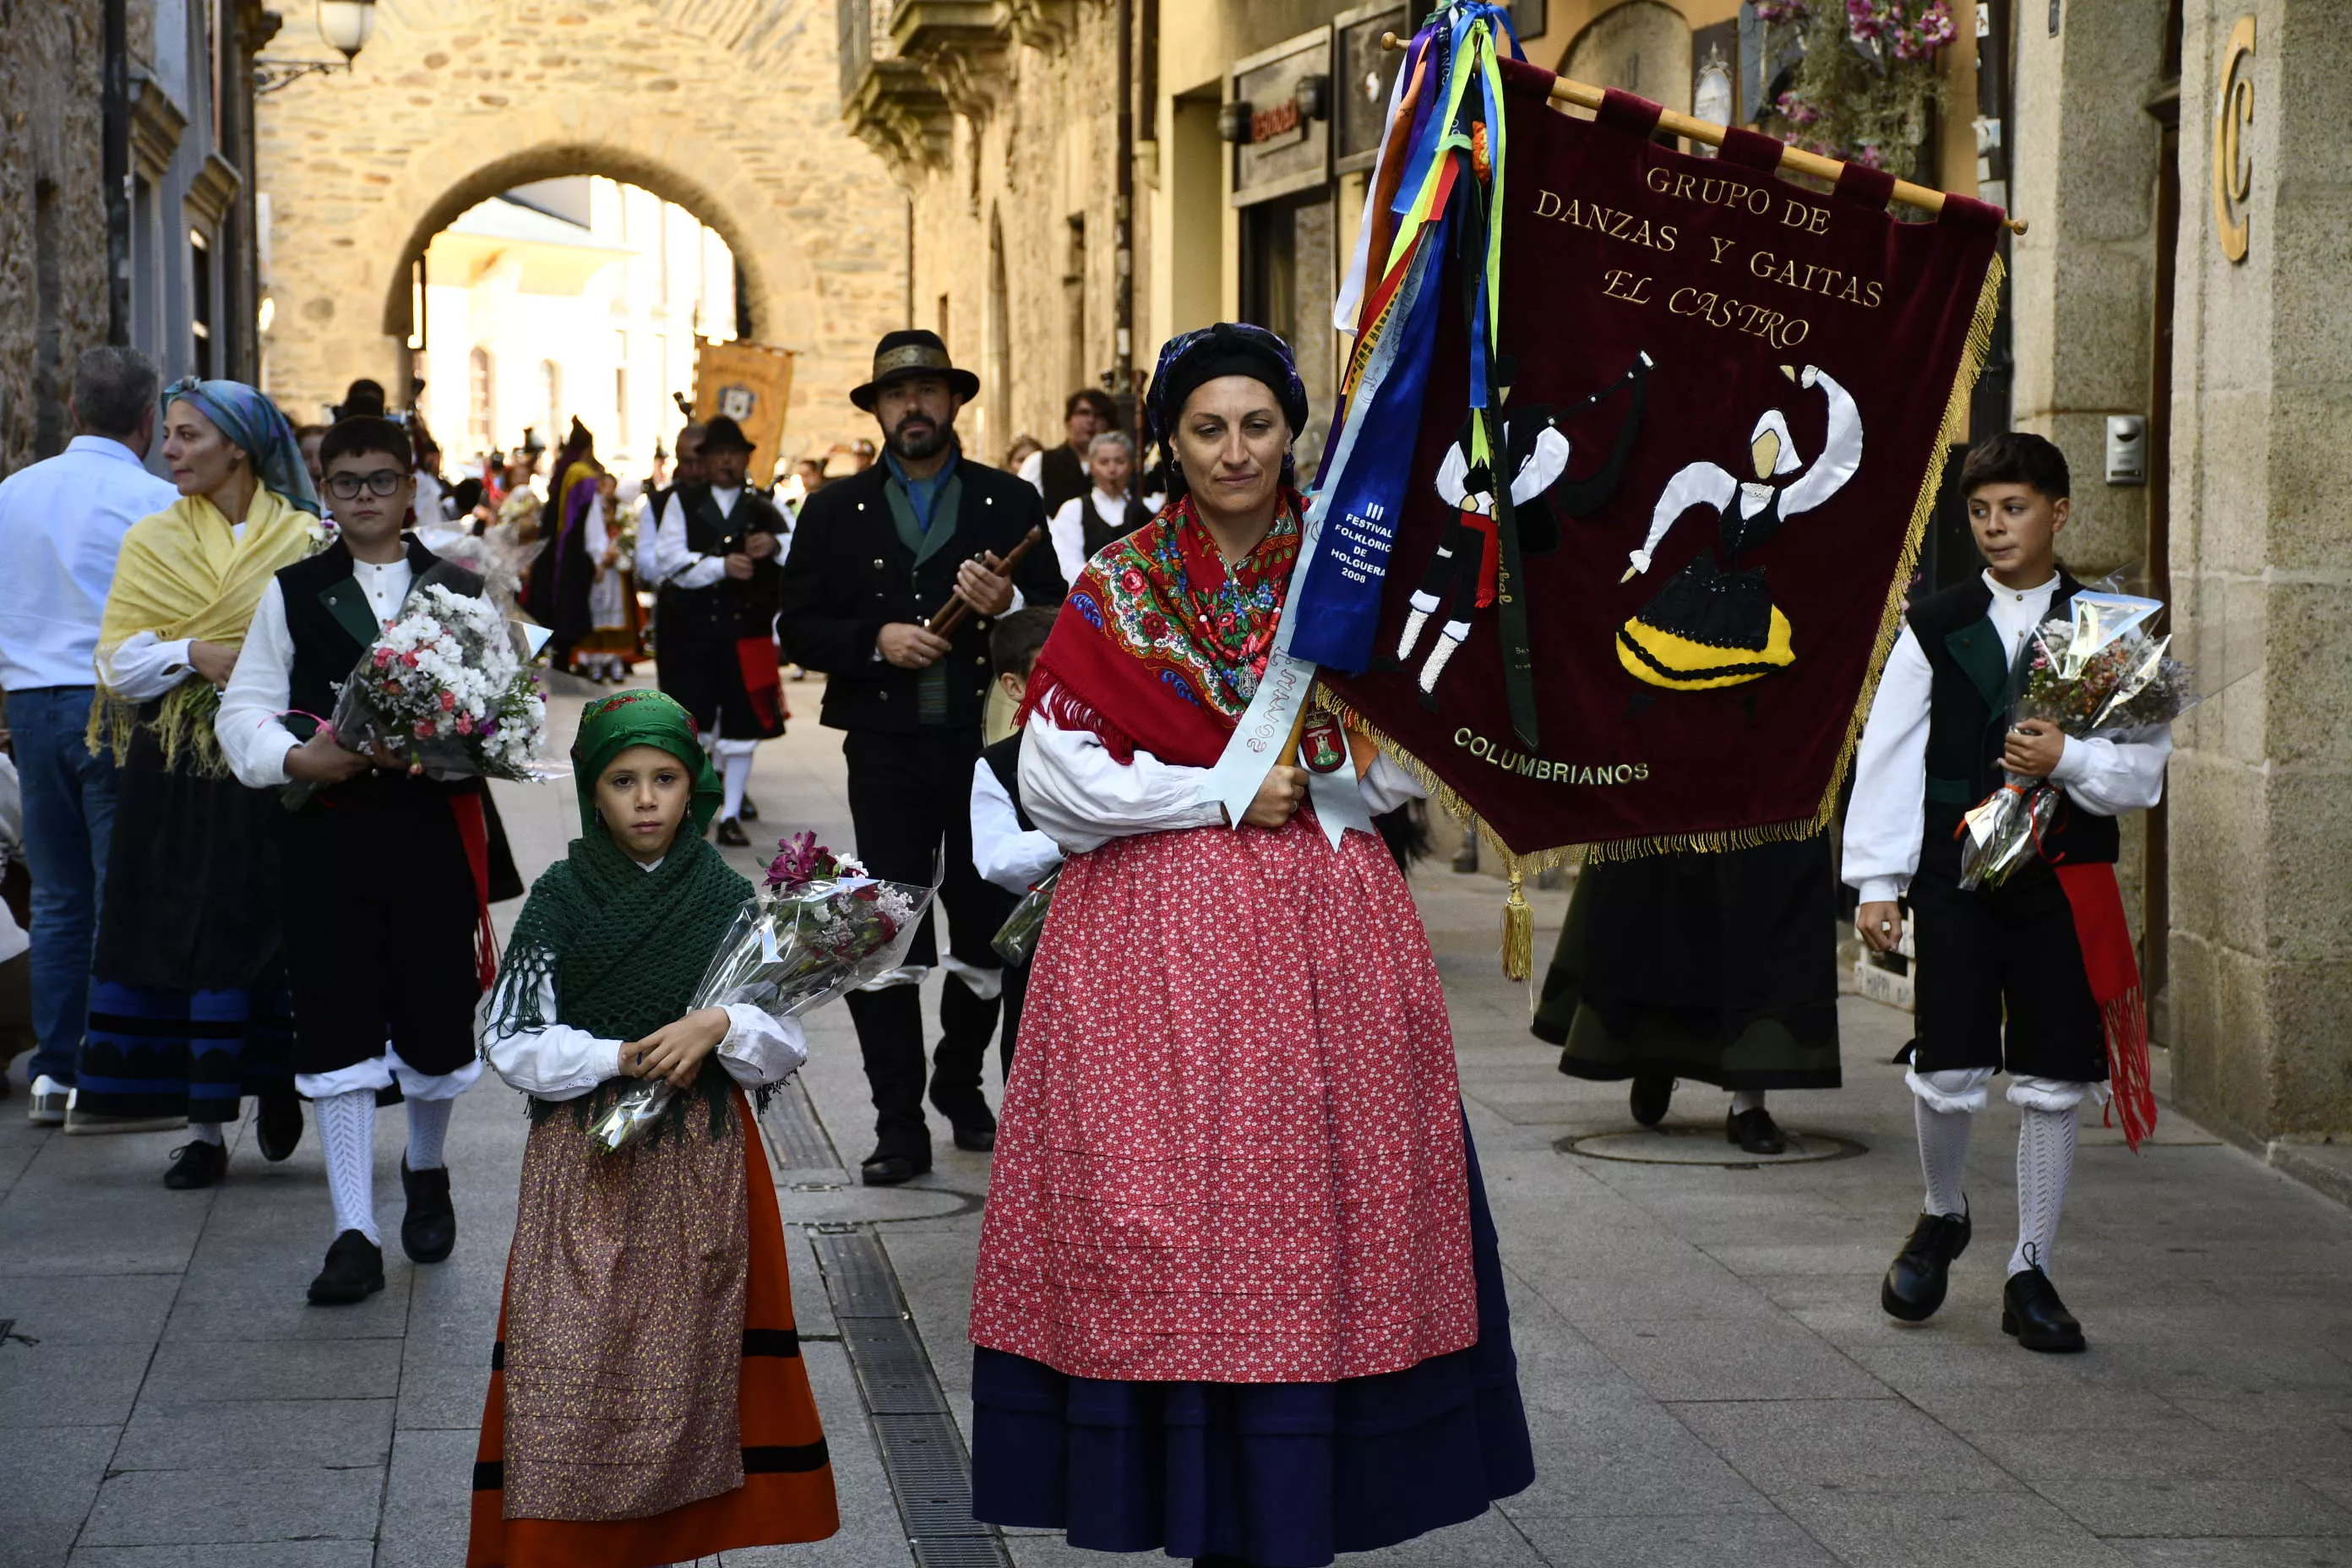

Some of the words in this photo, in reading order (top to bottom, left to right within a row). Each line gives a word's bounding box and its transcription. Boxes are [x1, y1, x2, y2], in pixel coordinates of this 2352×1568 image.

[1647, 166, 1770, 215] GRUPO
[1780, 199, 1831, 235] DE
[1533, 189, 1678, 252] DANZAS
[1710, 236, 1736, 264] Y
[1750, 251, 1884, 308] GAITAS
[1603, 270, 1653, 305] EL
[1669, 286, 1810, 349] CASTRO
[1345, 513, 1393, 538] FESTIVAL
[1365, 501, 1385, 521] III
[1334, 524, 1393, 553] FOLKLORIC
[1353, 545, 1368, 558] DE
[1331, 547, 1386, 577] HOLGUERA
[1341, 567, 1366, 584] 2008
[1453, 727, 1649, 786] COLUMBRIANOS
